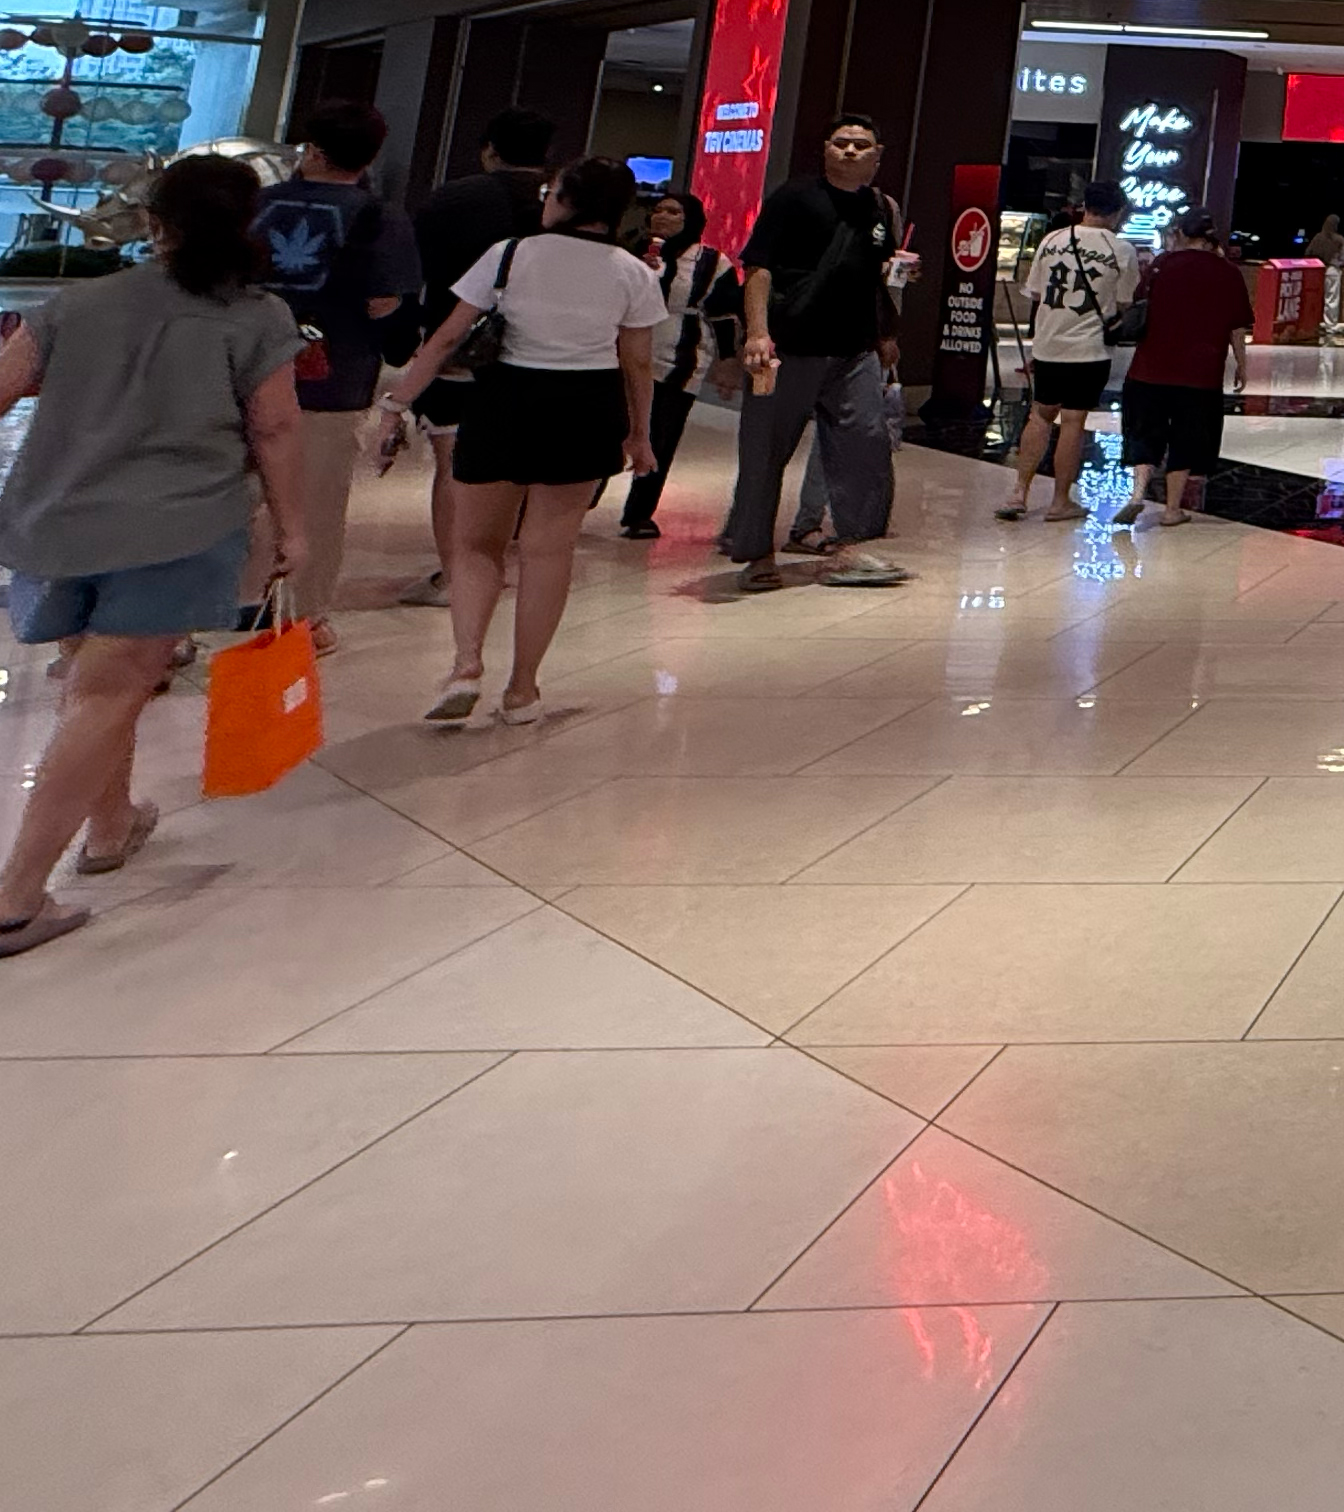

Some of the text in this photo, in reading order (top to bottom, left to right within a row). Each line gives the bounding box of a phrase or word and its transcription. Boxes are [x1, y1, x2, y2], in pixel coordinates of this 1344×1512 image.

[1118, 102, 1193, 138] Make
[1122, 140, 1181, 173] Your
[1119, 176, 1187, 207] Coffee
[958, 282, 974, 295] NO
[947, 295, 984, 310] OUTSIDE
[950, 310, 977, 324] FOOD
[942, 324, 982, 339] & DRINKS
[940, 339, 982, 354] ALLOWED
